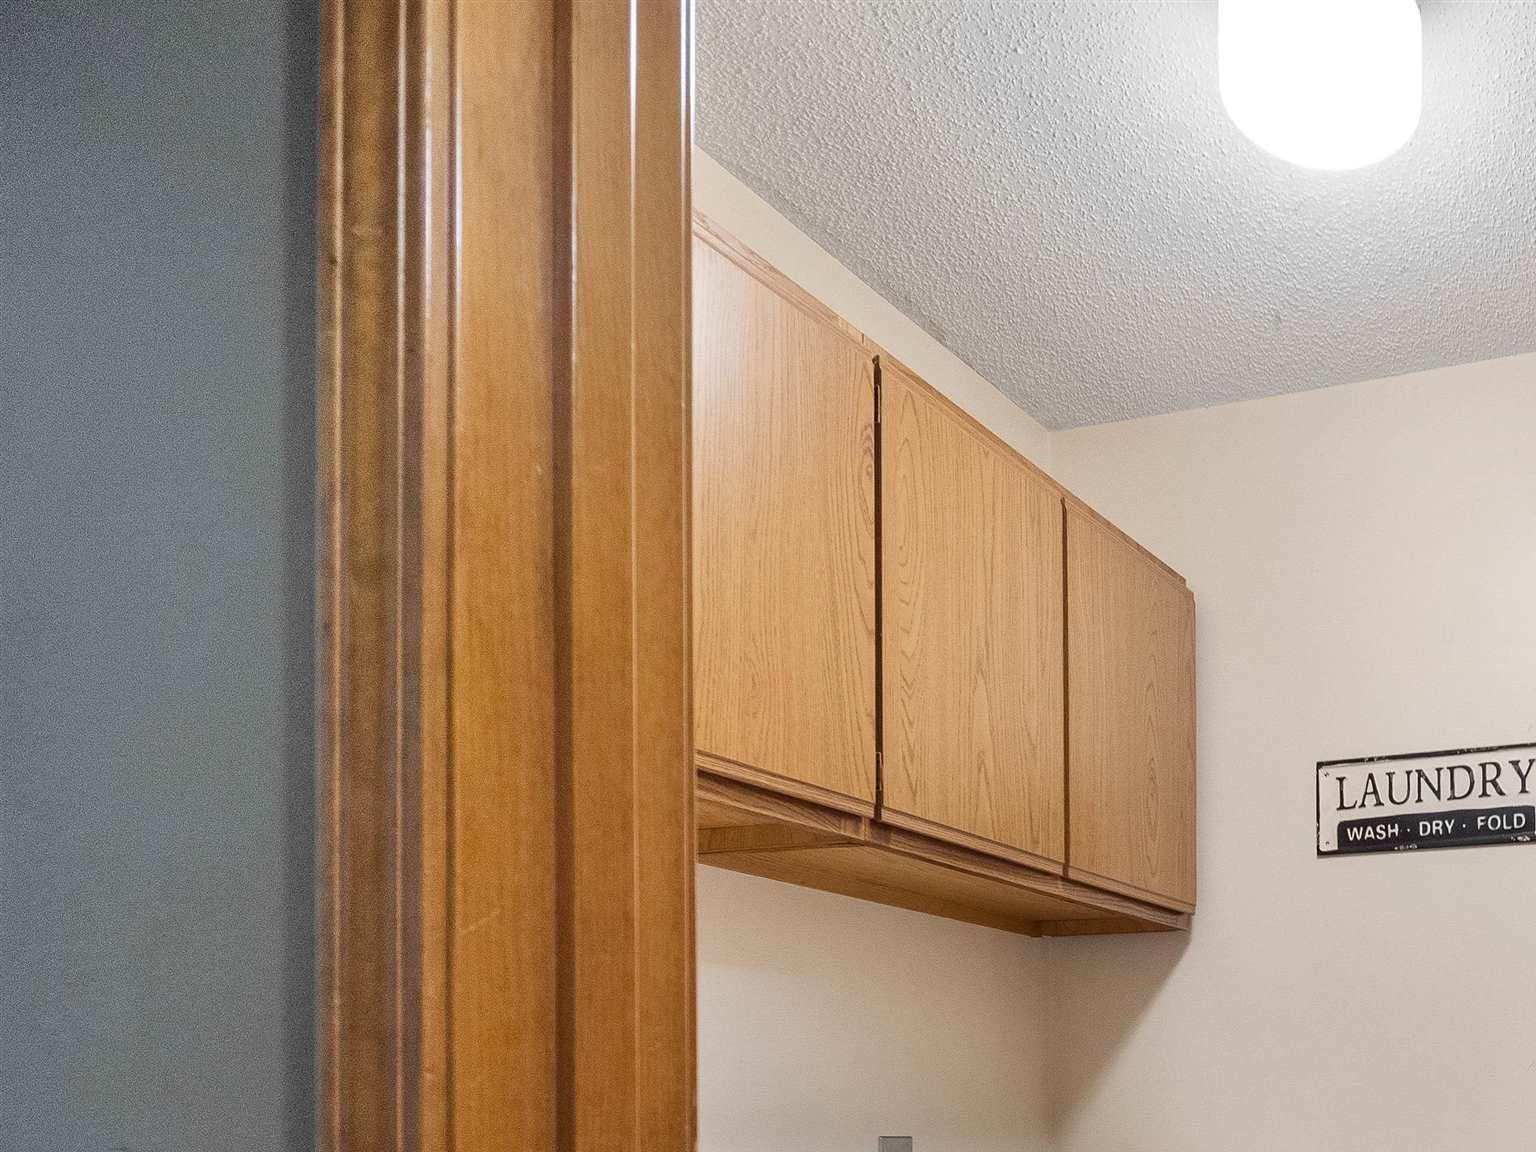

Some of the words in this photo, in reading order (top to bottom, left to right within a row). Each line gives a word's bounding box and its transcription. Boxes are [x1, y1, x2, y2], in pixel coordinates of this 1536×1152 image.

[1336, 758, 1536, 811] LAUNDRY
[1347, 823, 1399, 841] WASH
[1418, 819, 1455, 837] DRY
[1477, 813, 1526, 831] FOLD
